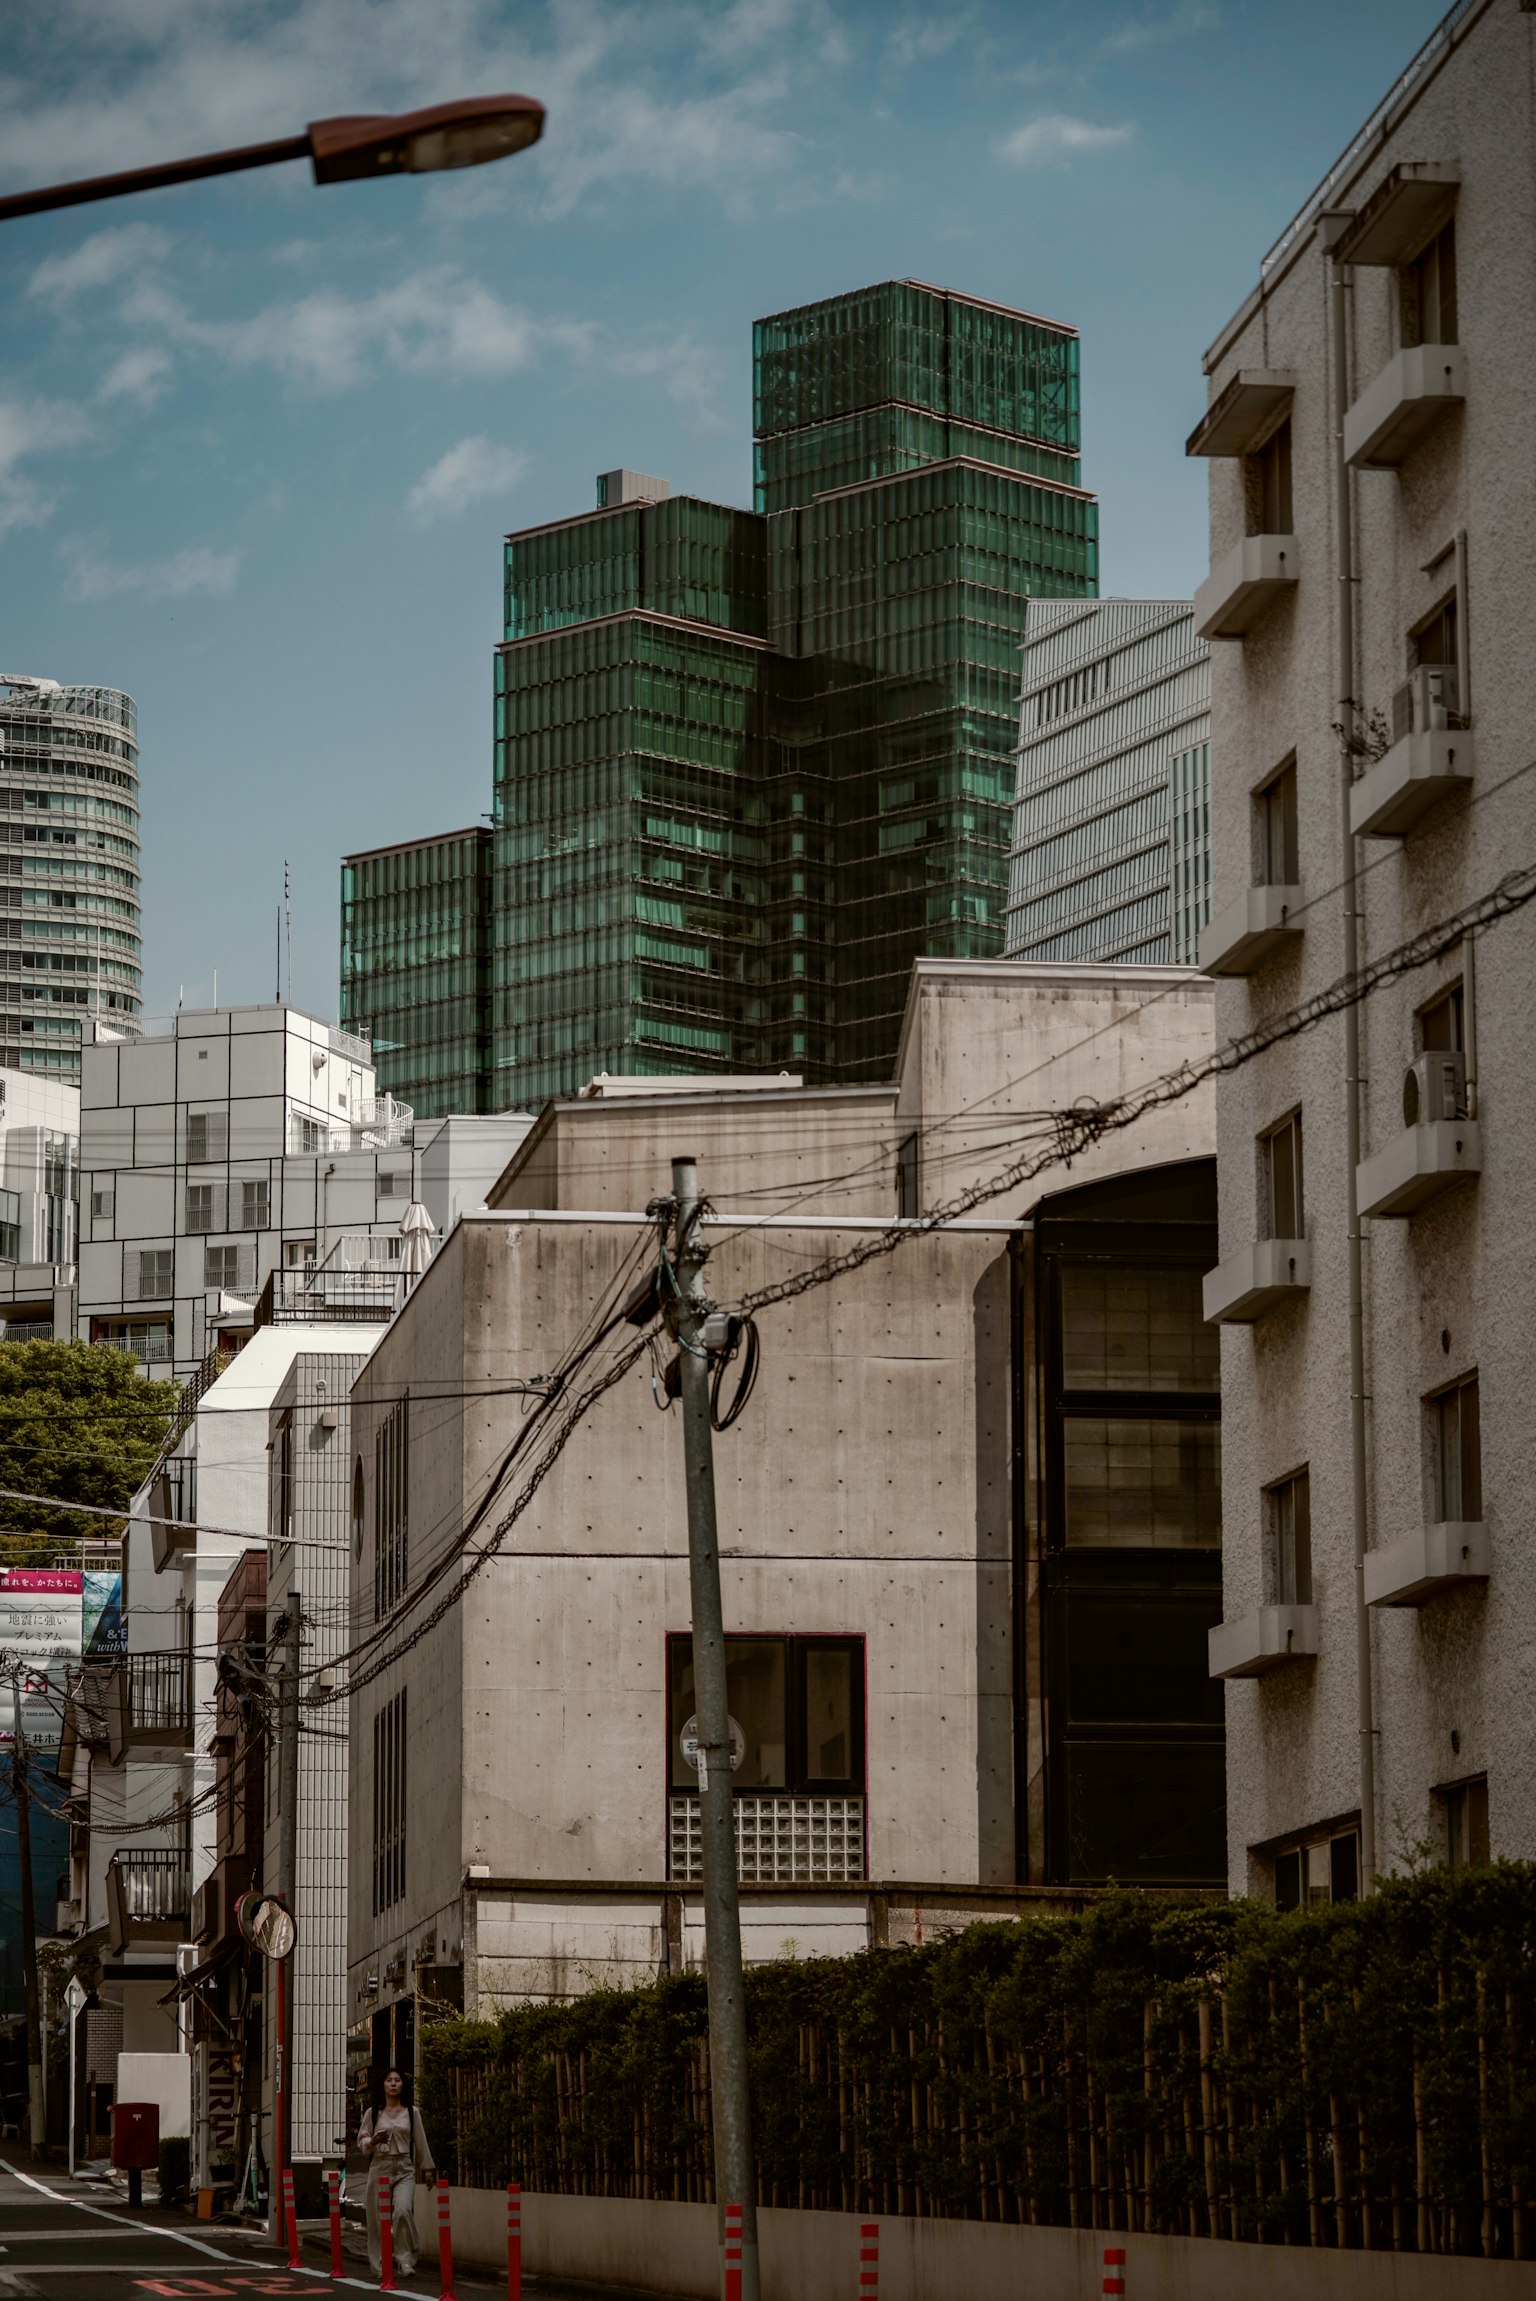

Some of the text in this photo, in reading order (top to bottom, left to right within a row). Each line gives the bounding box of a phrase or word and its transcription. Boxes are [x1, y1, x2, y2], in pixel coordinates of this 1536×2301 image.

[8, 1614, 67, 1626] 地震に強い
[14, 1630, 62, 1641] プレミアム
[107, 1629, 118, 1639] &
[97, 1641, 120, 1652] with
[208, 2050, 235, 2149] KIRIN
